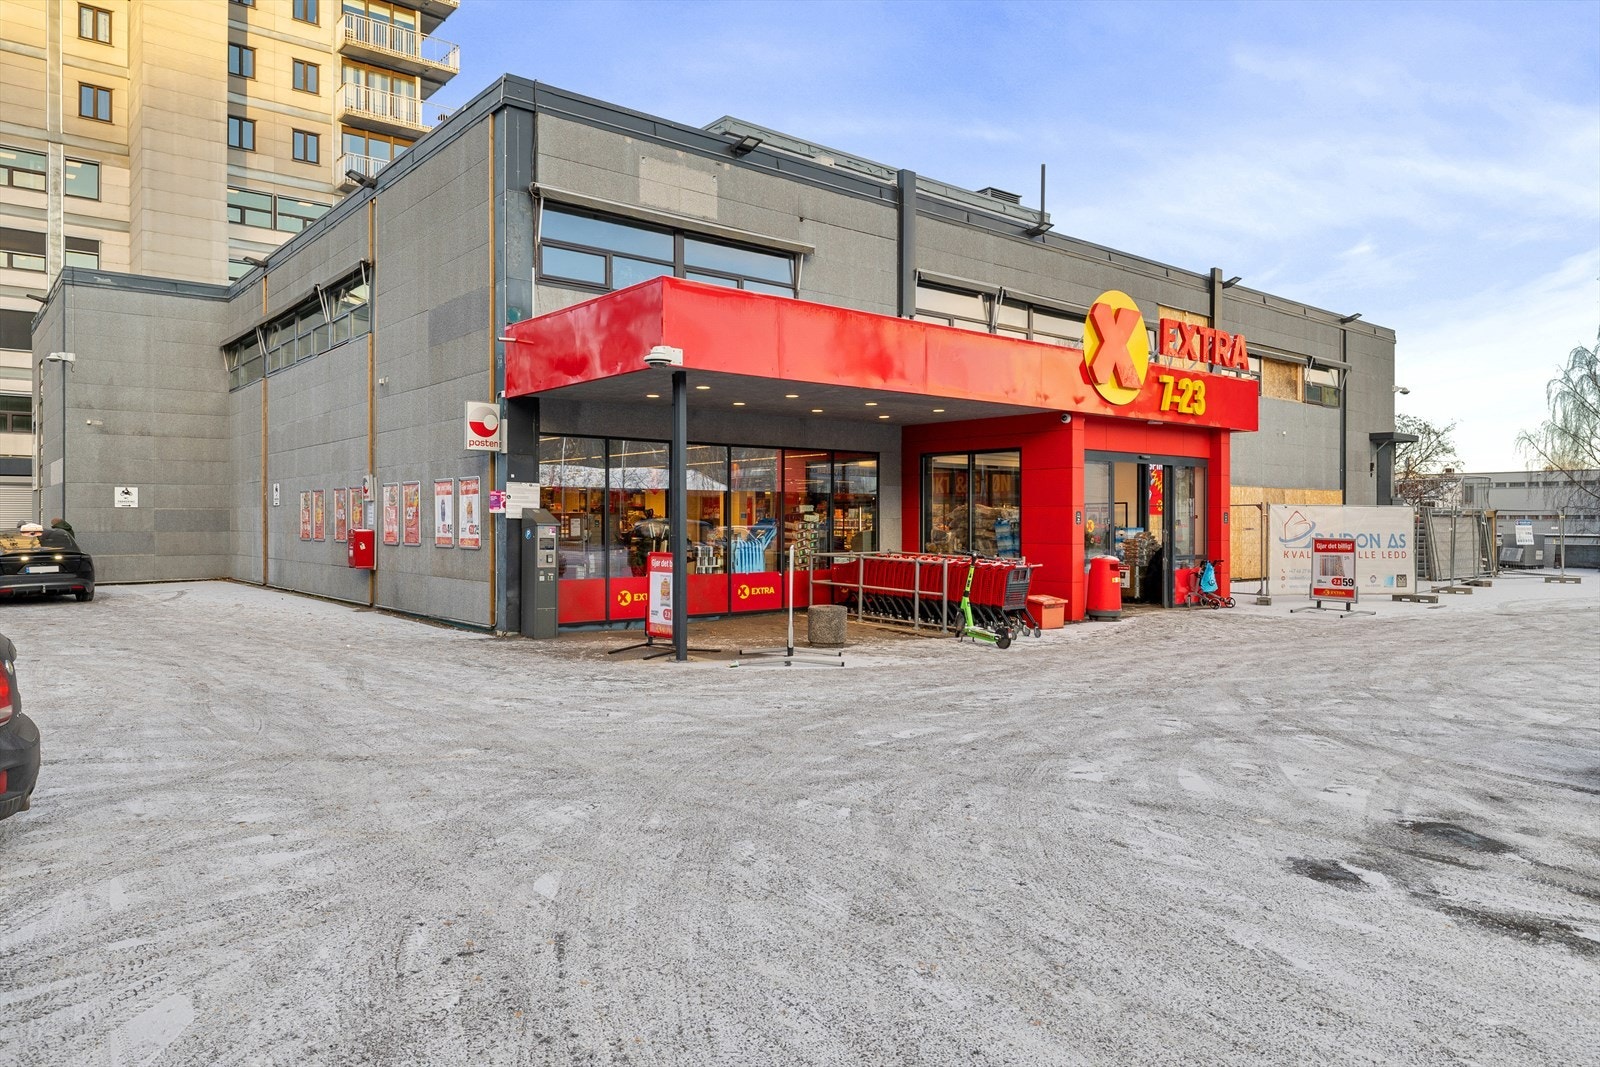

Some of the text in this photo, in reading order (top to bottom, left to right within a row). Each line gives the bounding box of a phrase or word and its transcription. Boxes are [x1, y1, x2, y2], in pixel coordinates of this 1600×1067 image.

[1160, 318, 1250, 371] EXTRA
[1159, 375, 1206, 415] 7-23
[469, 439, 499, 448] posten
[1387, 533, 1406, 549] AS
[1358, 551, 1376, 559] LLE
[1382, 551, 1407, 559] LEDD
[1342, 578, 1354, 586] 59
[751, 587, 775, 595] EXTRA
[633, 593, 648, 601] EXT
